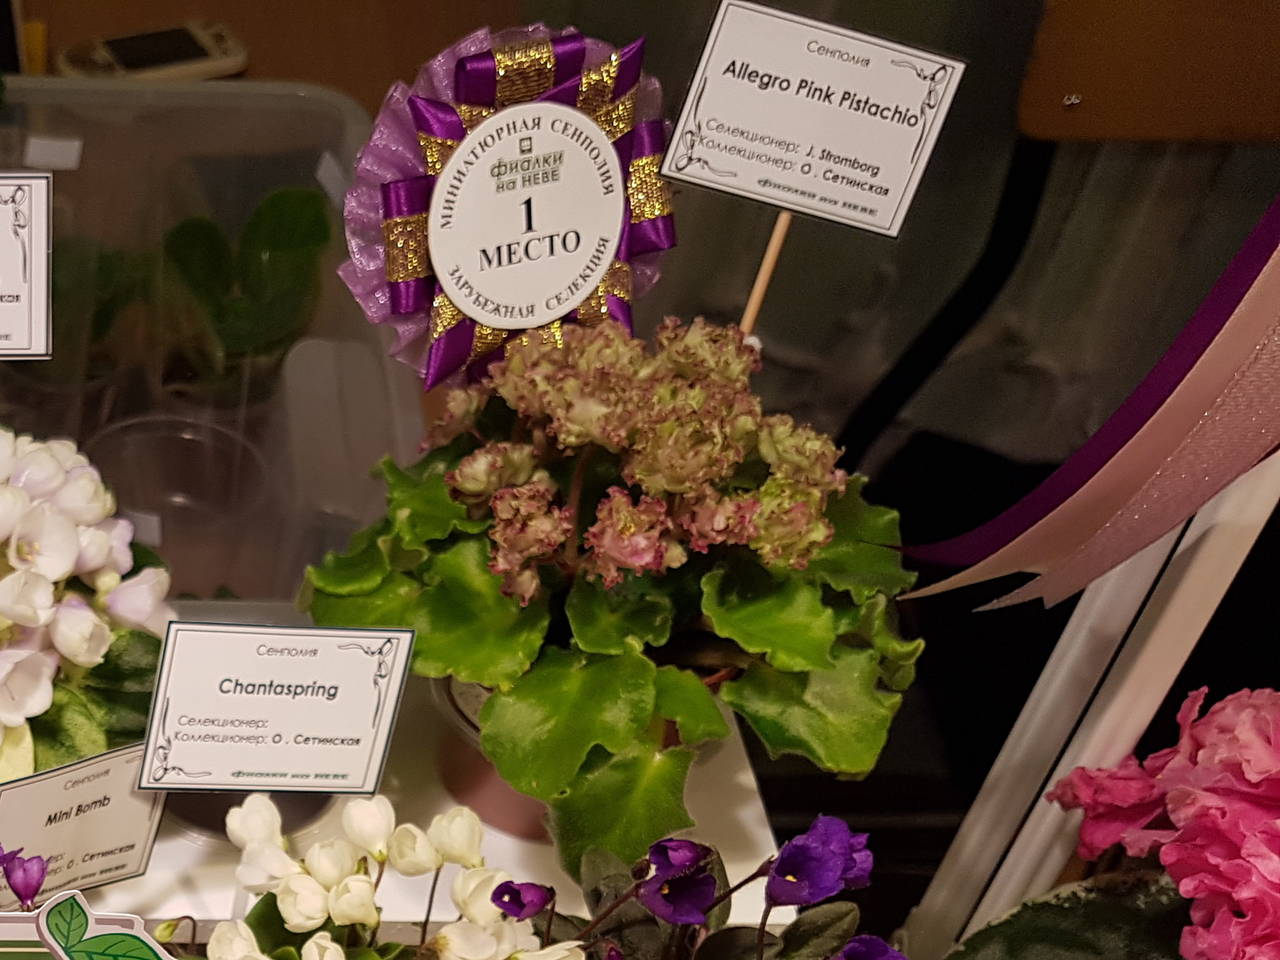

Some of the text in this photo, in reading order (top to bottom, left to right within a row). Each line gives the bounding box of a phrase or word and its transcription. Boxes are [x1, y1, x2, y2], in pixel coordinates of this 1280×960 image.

[806, 40, 870, 67] Сенполия
[722, 60, 919, 128] Allegro Pink Pistachio
[706, 118, 800, 153] Селекционер:
[808, 145, 815, 158] J.
[440, 117, 614, 229] МИНИАТЮРНАЯ СЕНПОЛИЯ
[522, 169, 560, 188] НЕВЕ
[822, 170, 890, 197] Сетинская
[520, 197, 538, 234] 1
[479, 230, 581, 271] МЕСТО
[448, 237, 610, 318] ЗАРУБЕЖНАЯ СЕЛЕКЦИЯ
[256, 644, 318, 658] Сенполия
[219, 678, 338, 700] Chantaspring
[178, 715, 268, 729] Селекционер:
[173, 731, 268, 745] Коллекционер:
[294, 735, 361, 746] Сетинская
[45, 795, 111, 827] Mini Bomb
